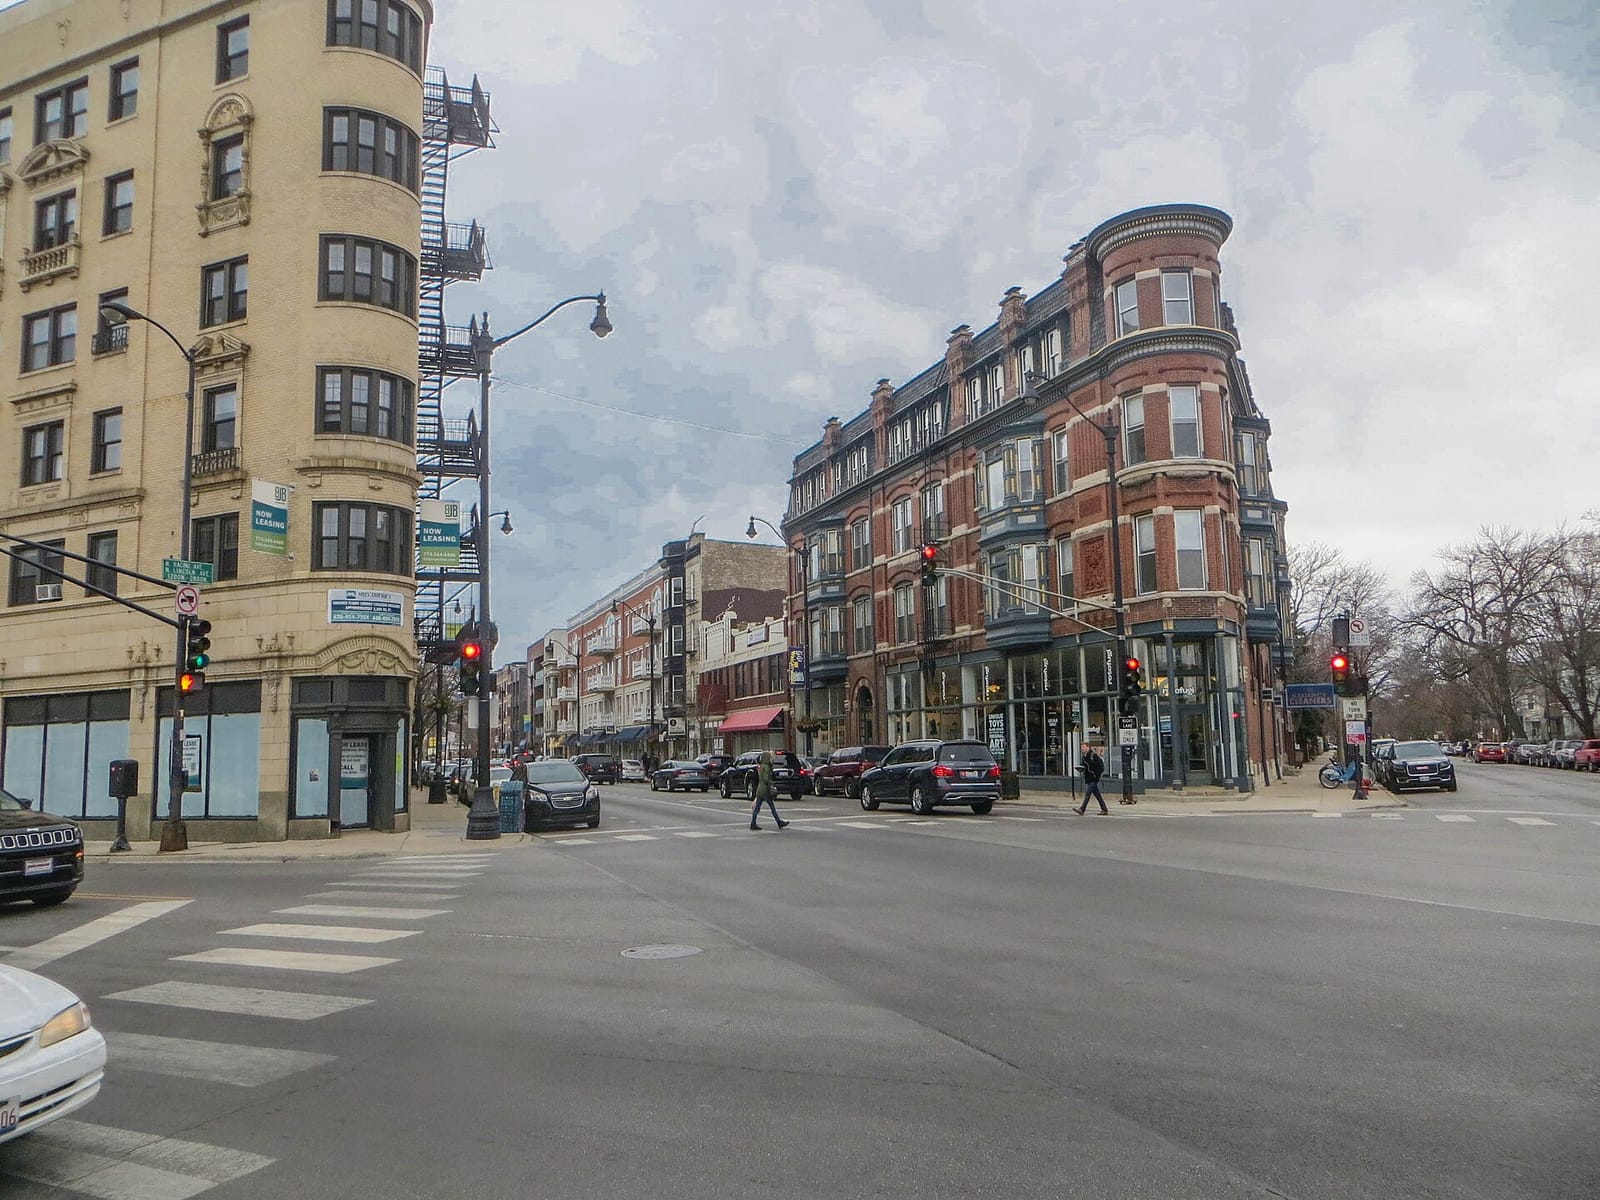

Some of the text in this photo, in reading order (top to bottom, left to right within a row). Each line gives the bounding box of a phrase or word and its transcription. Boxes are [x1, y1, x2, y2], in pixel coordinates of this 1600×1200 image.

[255, 510, 273, 519] NOW
[255, 518, 285, 529] LEASING
[423, 535, 457, 543] LEASING
[173, 567, 196, 575] LINCOLN
[988, 719, 1004, 728] TOYS
[989, 739, 1004, 749] ART
